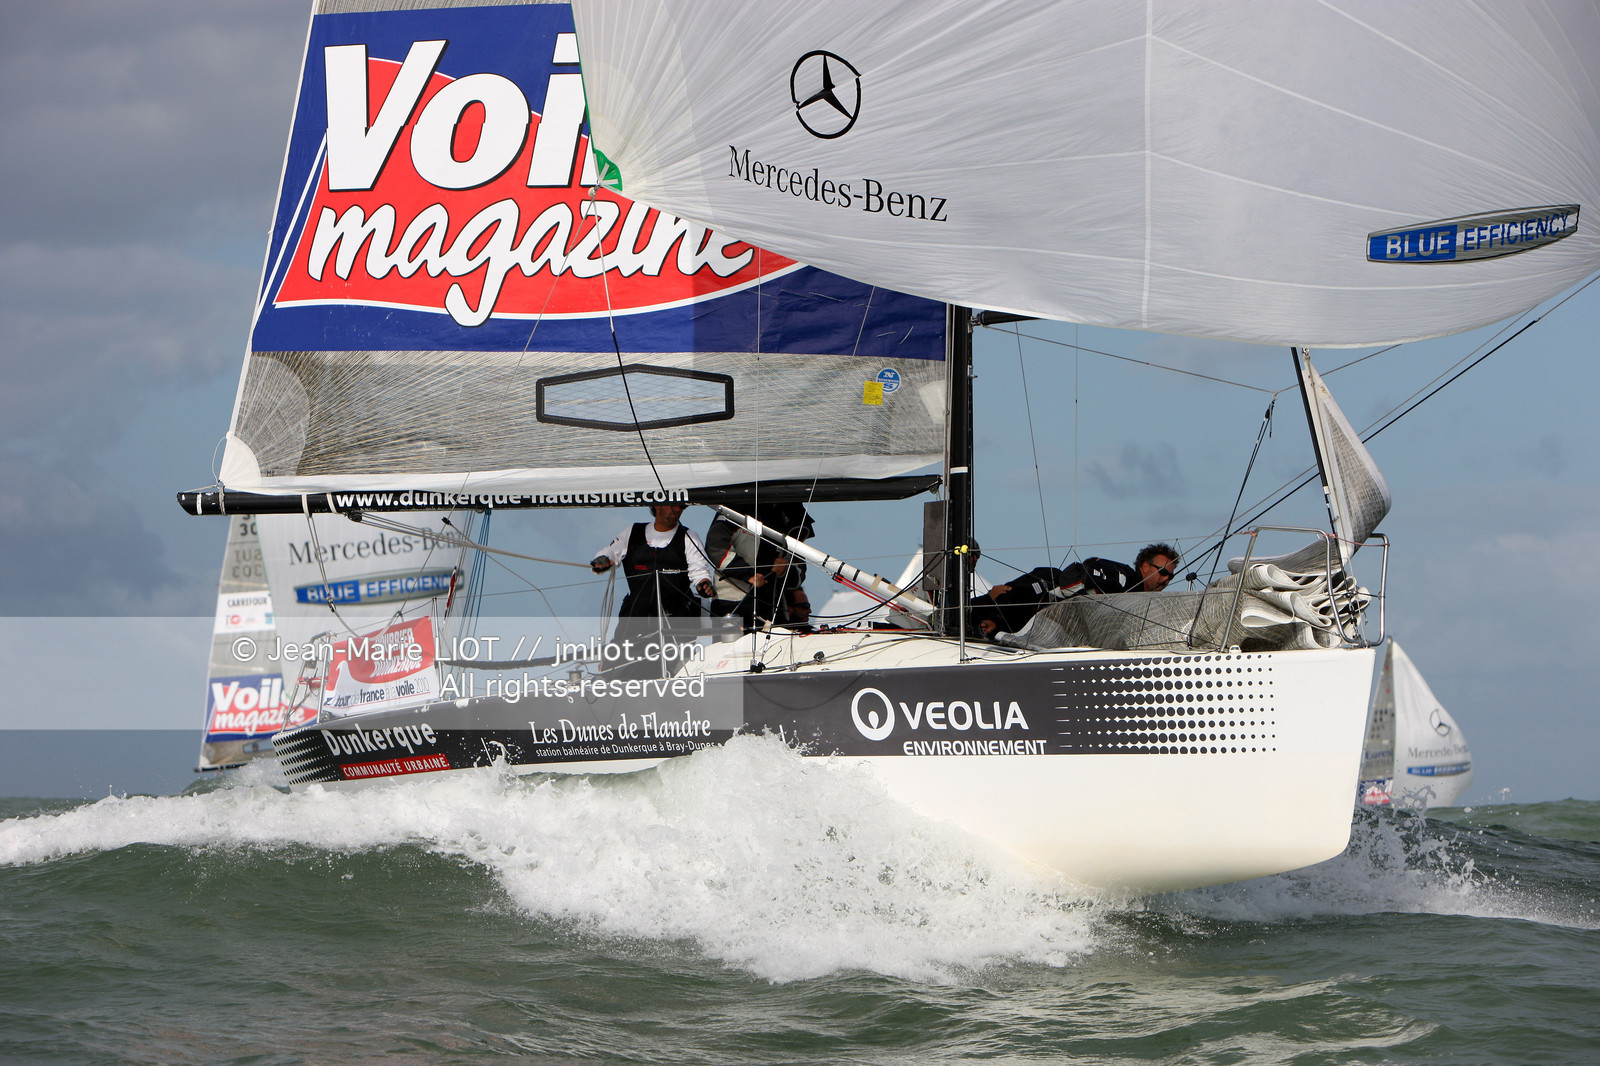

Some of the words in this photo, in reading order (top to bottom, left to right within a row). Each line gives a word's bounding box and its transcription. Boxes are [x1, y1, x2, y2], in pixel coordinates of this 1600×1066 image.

[728, 144, 948, 223] Mercedes-Benz
[1386, 231, 1451, 259] BLUE
[1463, 210, 1571, 252] EFFICIENCY
[307, 585, 356, 602] BLUE
[366, 573, 456, 598] EFFICIENC
[212, 678, 289, 712] Voil
[360, 688, 385, 704] france
[396, 680, 415, 698] voile
[528, 720, 558, 744] Les
[559, 718, 614, 744] Dunes
[618, 713, 639, 740] de
[641, 709, 712, 738] Flandre
[900, 701, 1029, 731] VEOLIA
[321, 723, 436, 757] Dunkerque
[535, 748, 561, 757] station
[563, 746, 599, 756] balnéaire
[600, 744, 611, 755] de
[613, 743, 657, 757] Dunkerque
[658, 741, 665, 752] à
[903, 740, 1047, 756] ENVIRONNEMENT
[343, 760, 403, 778] COMMUNAUTÉ
